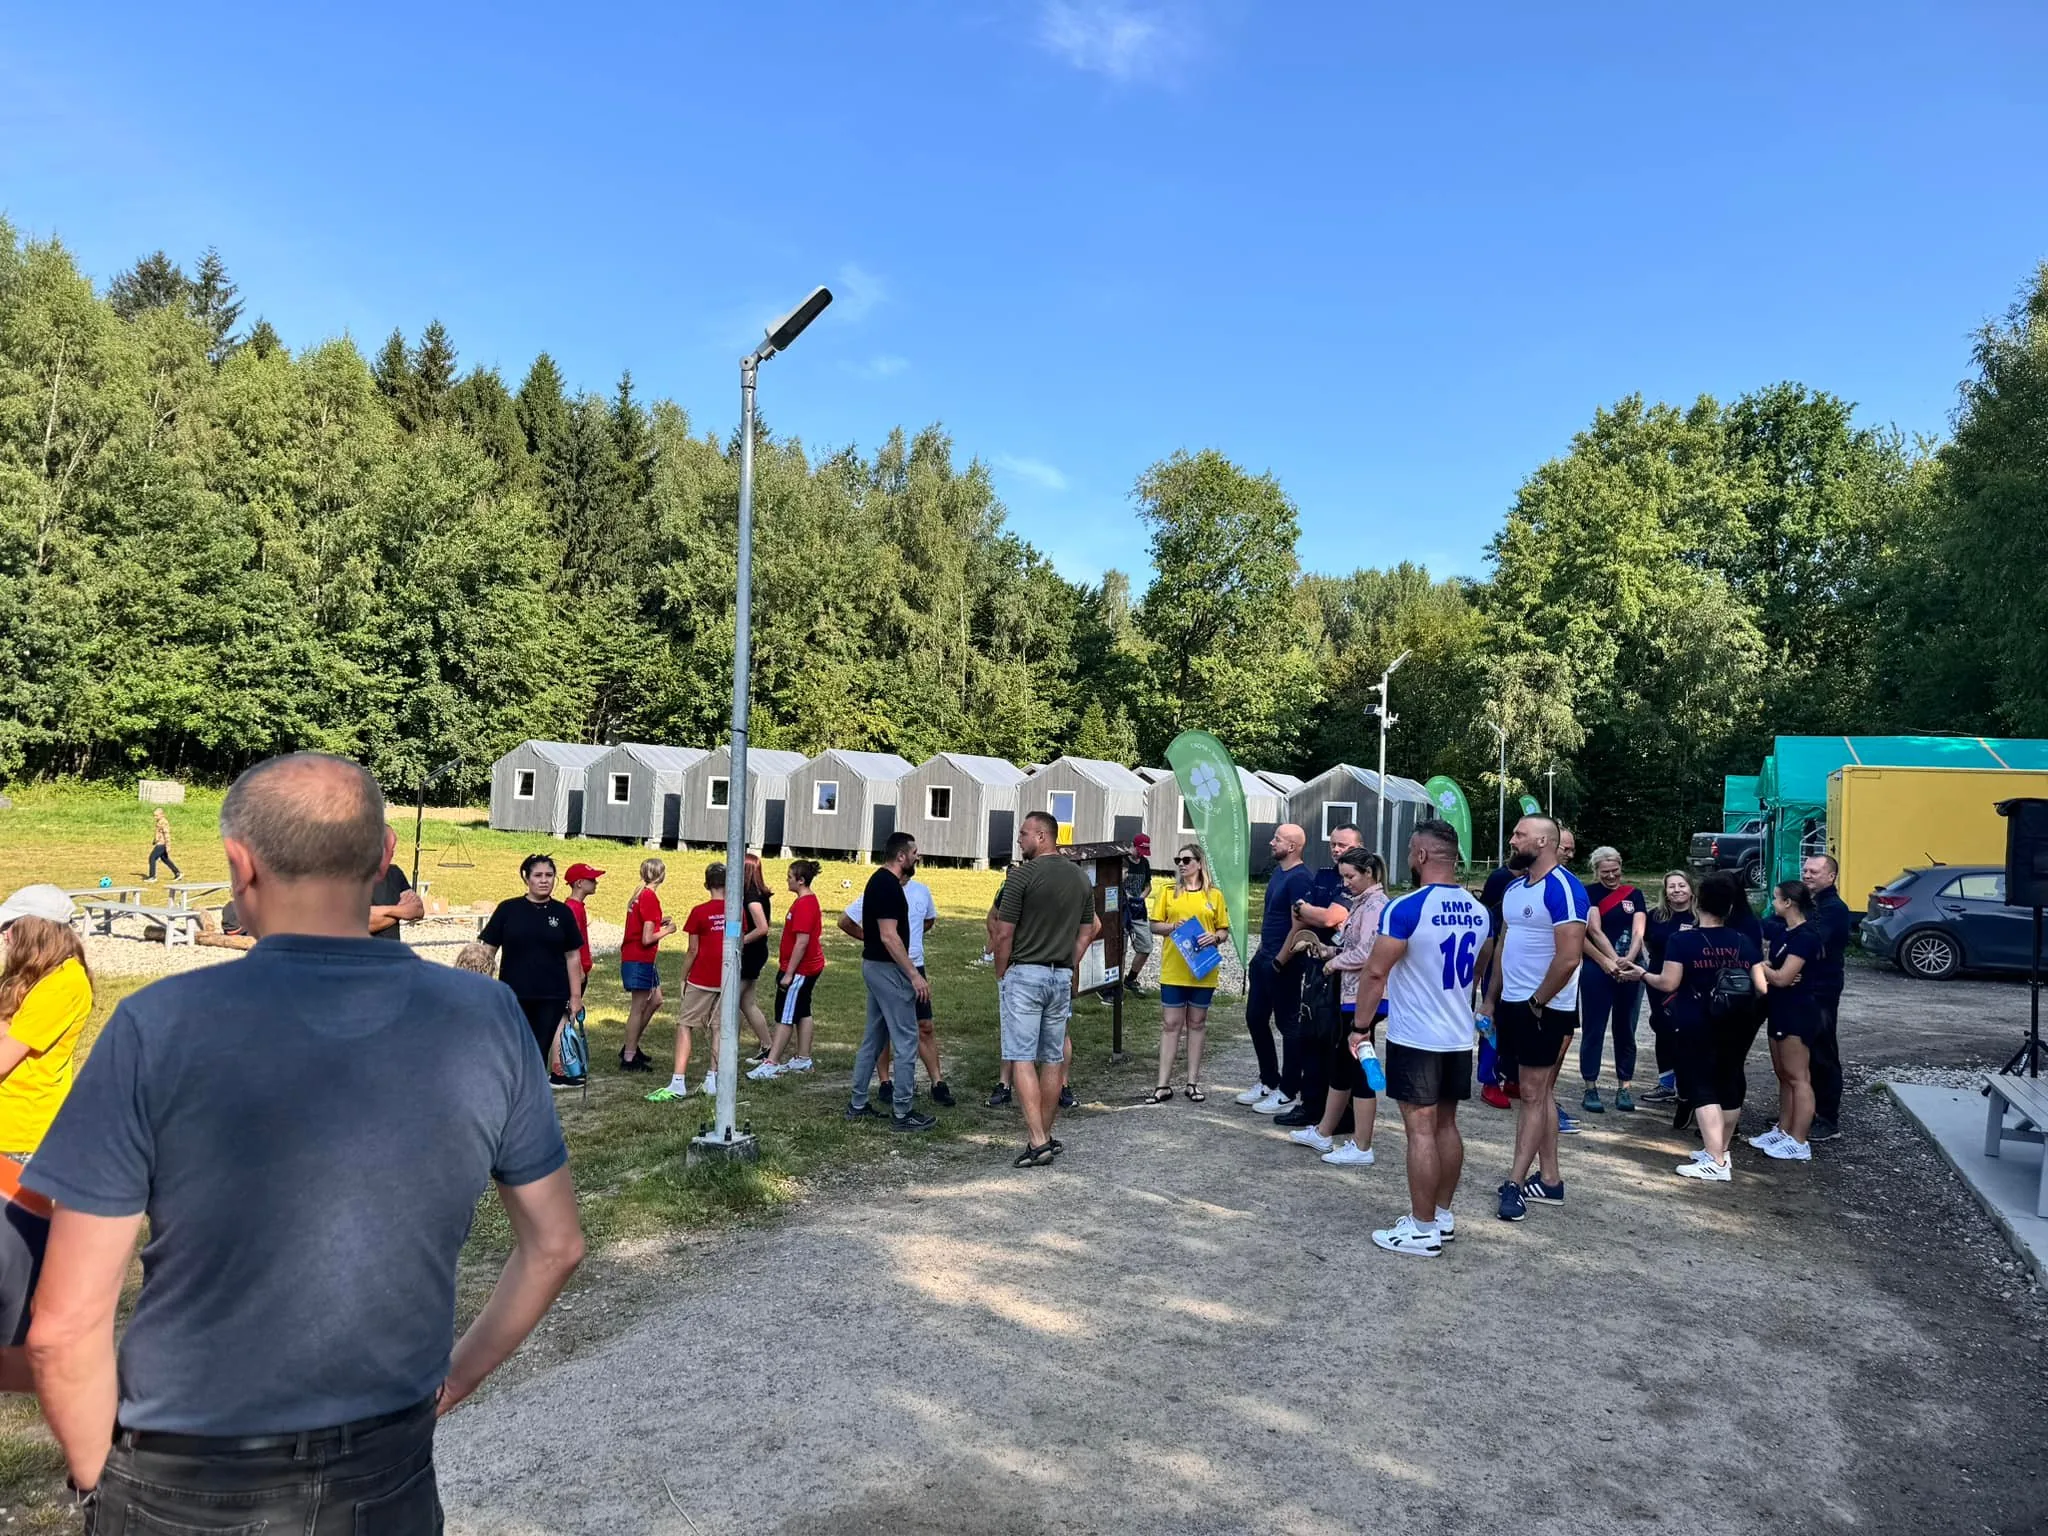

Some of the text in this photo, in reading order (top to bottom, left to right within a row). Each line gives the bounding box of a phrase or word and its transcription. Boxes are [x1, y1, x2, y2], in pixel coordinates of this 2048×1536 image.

[1442, 901, 1473, 913] KMP
[1432, 914, 1483, 929] ELBLĄG
[1439, 931, 1476, 990] 16
